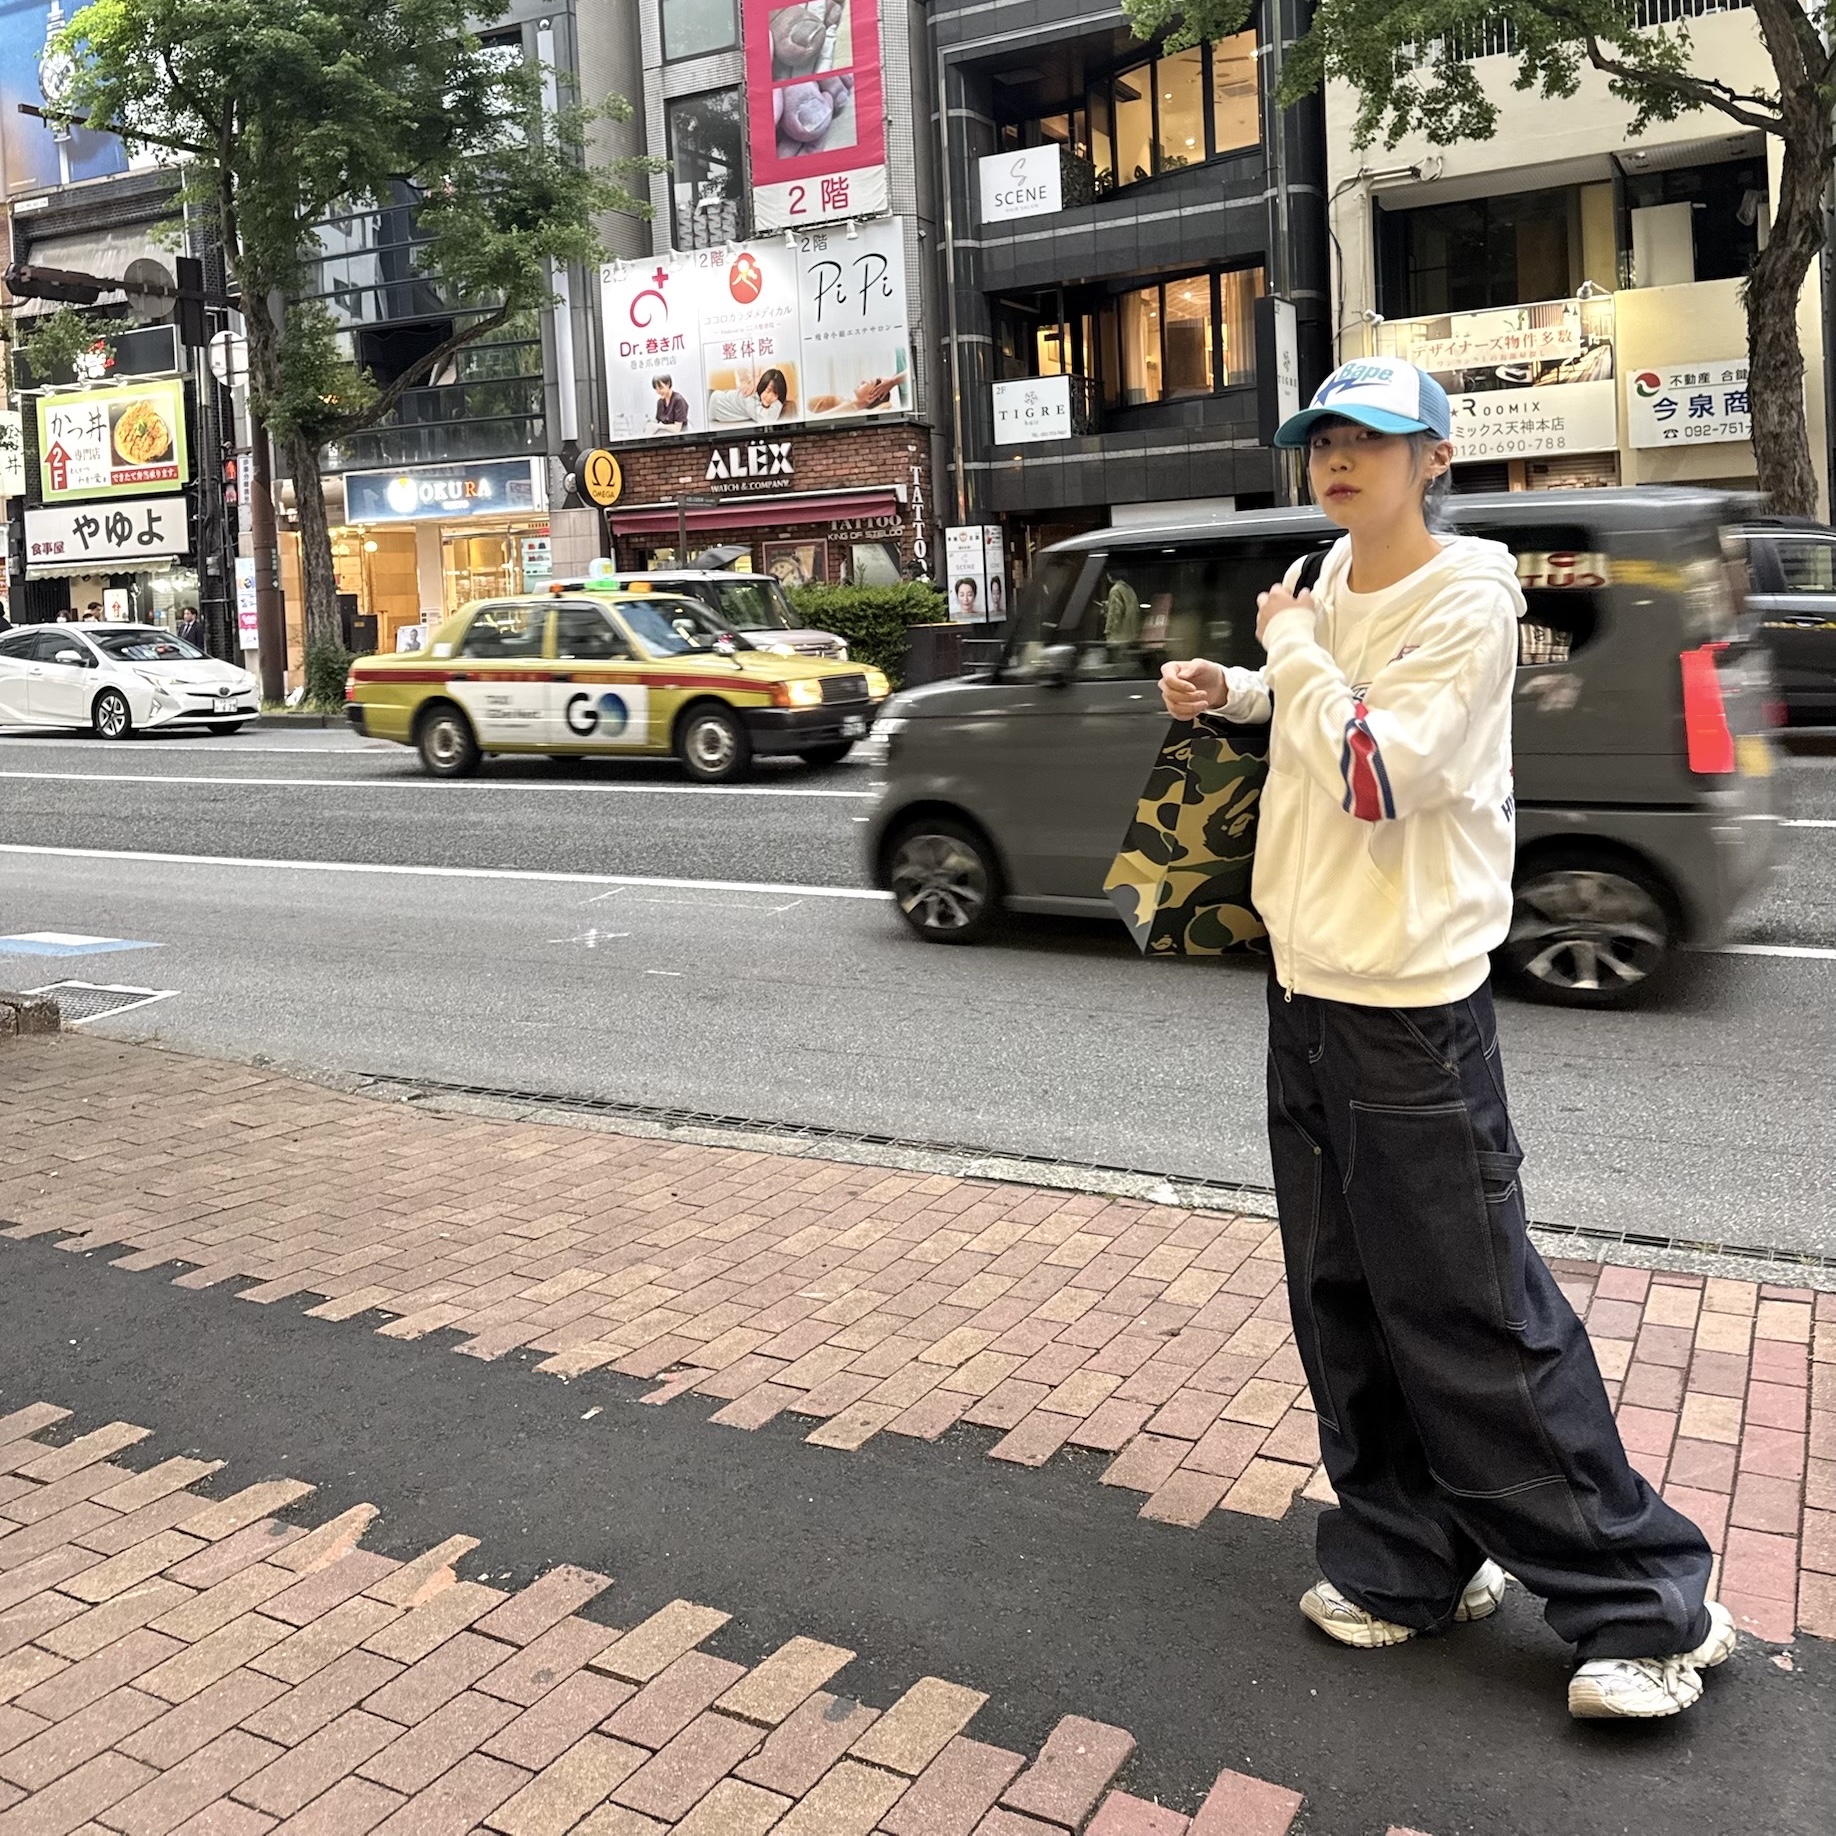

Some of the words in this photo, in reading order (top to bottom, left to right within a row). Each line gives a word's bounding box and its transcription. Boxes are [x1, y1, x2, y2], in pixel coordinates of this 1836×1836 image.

[788, 176, 850, 215] 2階
[994, 185, 1047, 207] SCENE
[800, 234, 828, 253] 2階
[699, 250, 725, 268] 2階
[619, 341, 643, 358] Dr.
[645, 333, 686, 355] 巻き爪
[722, 337, 774, 361] 整体院
[1412, 328, 1573, 359] デザイナーズ物件多数
[1337, 362, 1394, 383] Bape
[1669, 372, 1711, 387] 不動産
[998, 404, 1065, 420] TIGRE
[1652, 390, 1748, 421] 今泉商
[51, 405, 107, 442] かつ丼
[419, 479, 492, 501] OKURA
[592, 490, 615, 499] OMEGA
[710, 483, 740, 493] WATCH
[31, 541, 65, 556] 食事屋
[72, 508, 165, 550] やゆよ
[830, 514, 903, 531] TATTOO
[828, 532, 849, 541] KING
[850, 531, 863, 540] OF
